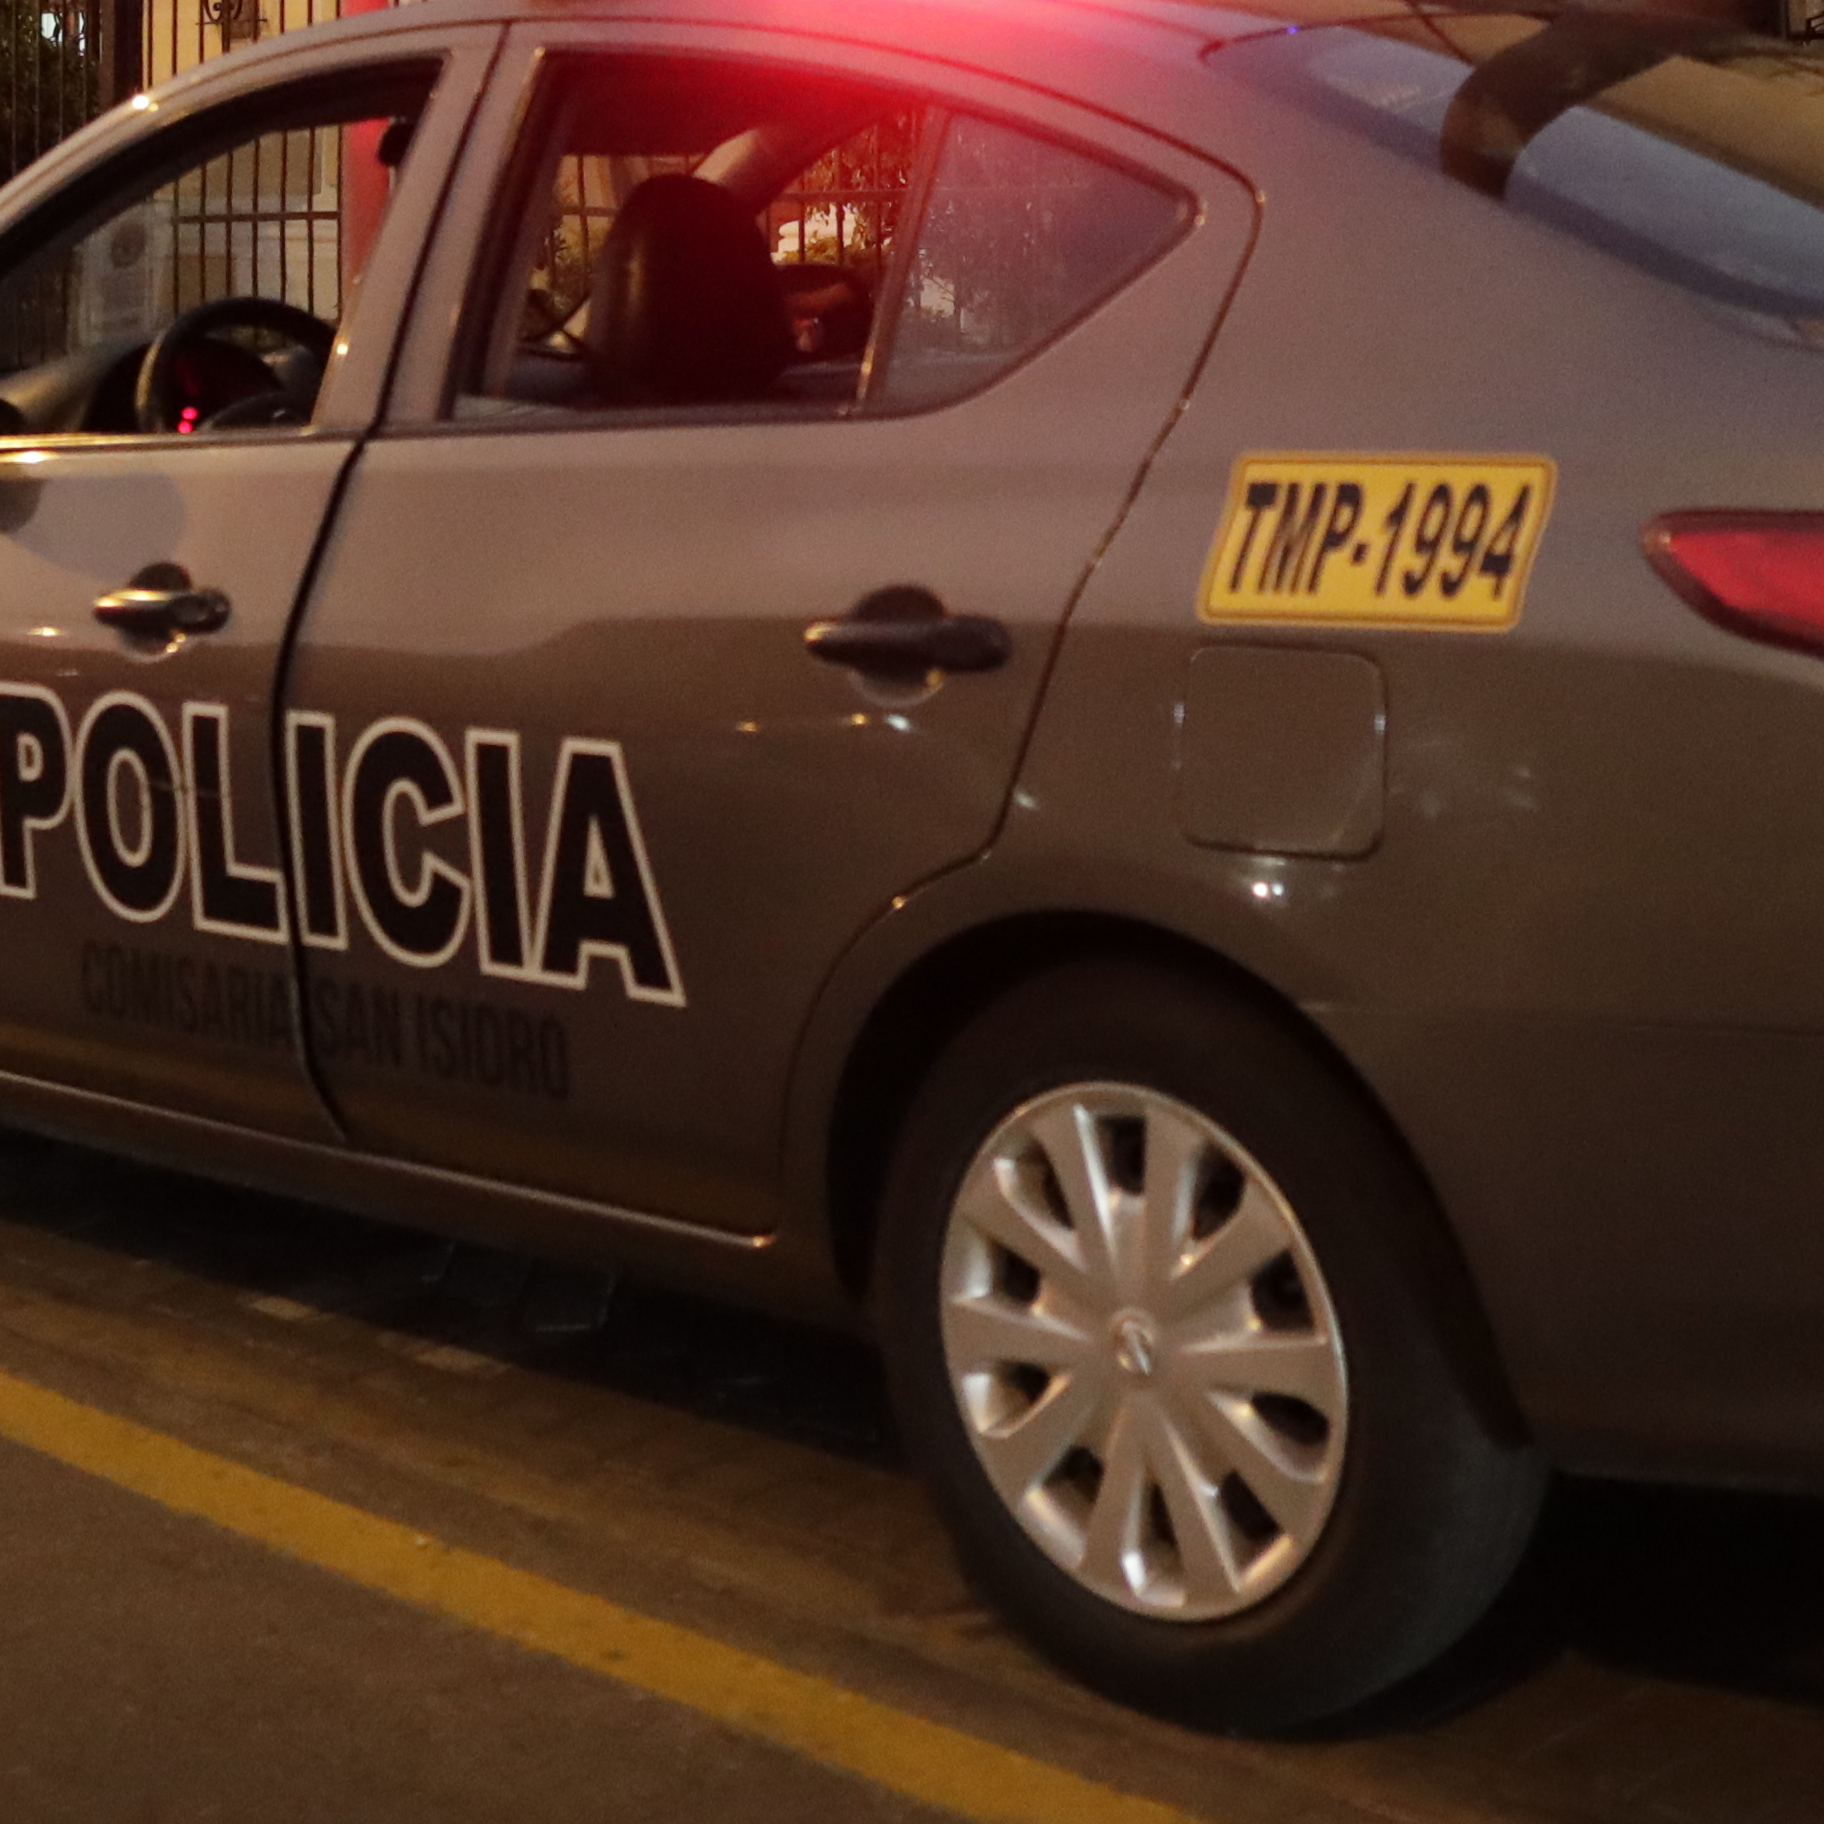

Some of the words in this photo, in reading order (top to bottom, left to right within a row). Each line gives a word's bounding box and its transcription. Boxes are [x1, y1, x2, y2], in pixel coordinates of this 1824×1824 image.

[1227, 482, 1531, 601] TMP-1994
[79, 939, 291, 1049] COMISARIA
[313, 974, 403, 1066] SAN
[415, 992, 573, 1101] ISIDRO
